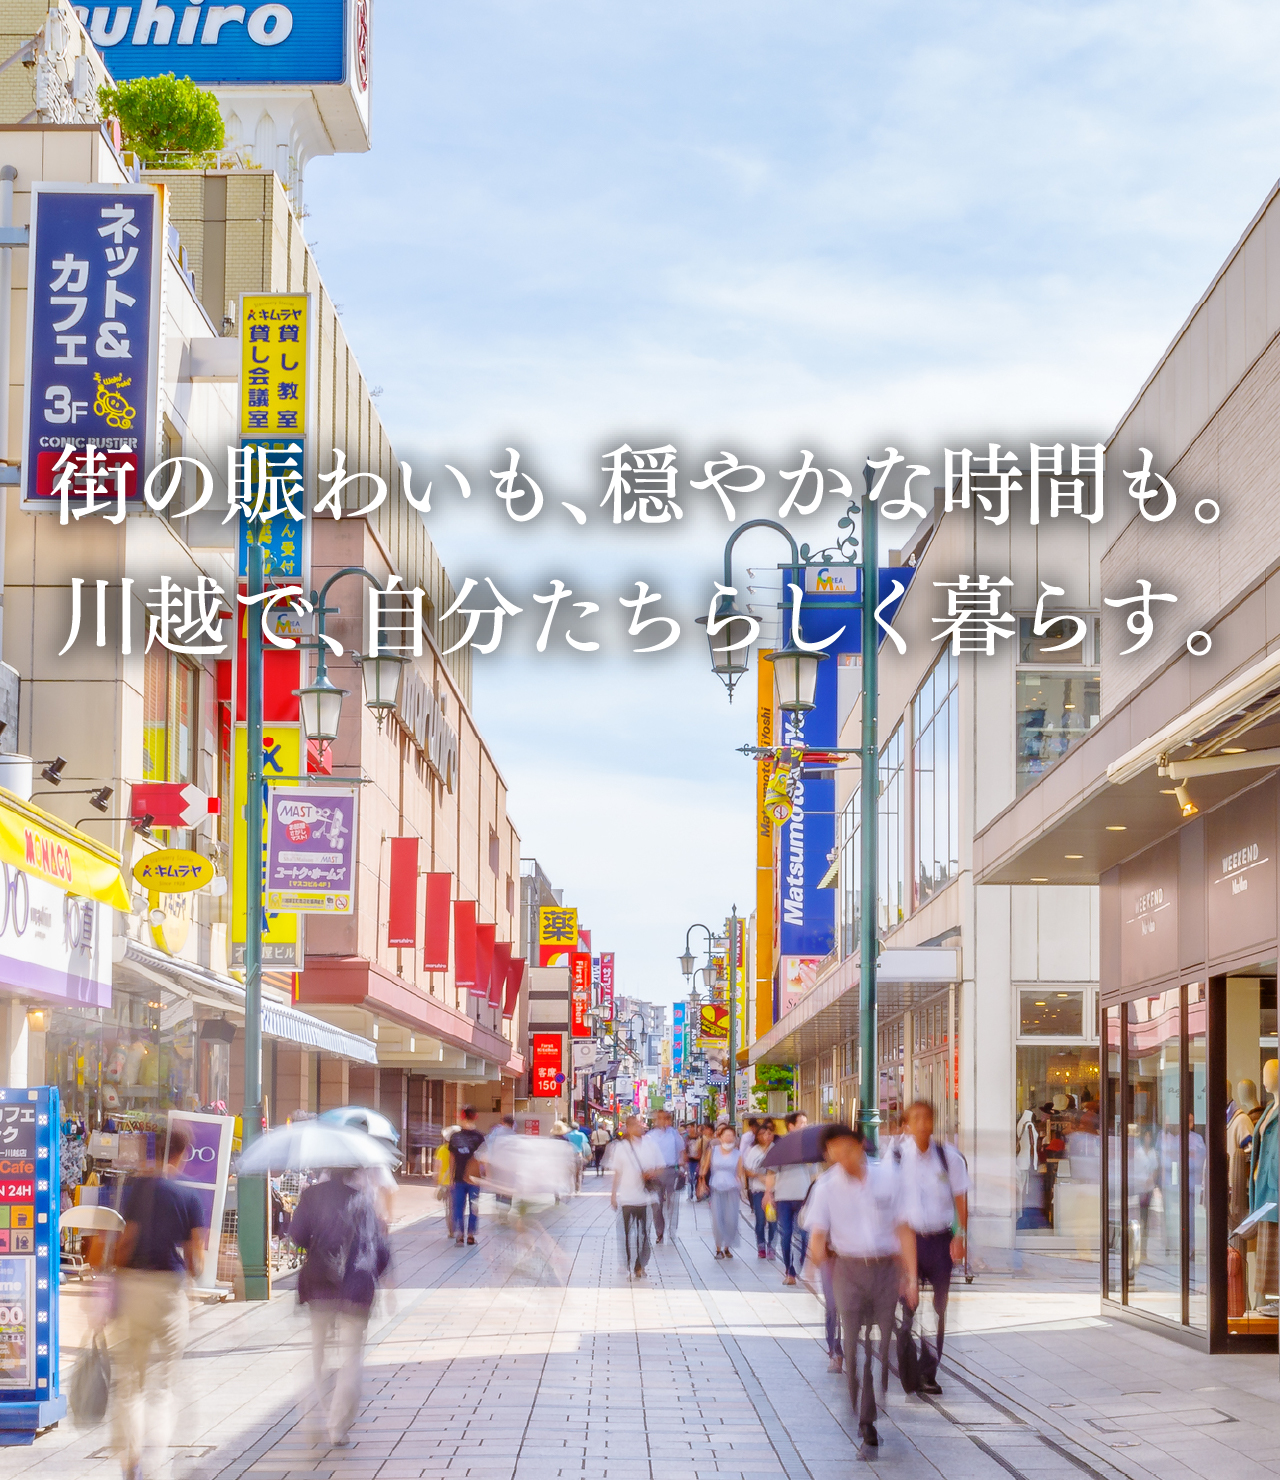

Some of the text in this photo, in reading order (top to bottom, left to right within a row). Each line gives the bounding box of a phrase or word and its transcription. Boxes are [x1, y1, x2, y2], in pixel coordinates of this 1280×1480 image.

[82, 0, 293, 46] uhiro
[49, 253, 89, 365] カフェ
[247, 324, 270, 428] 貸し会議室
[277, 324, 299, 428] 貸し教室
[44, 385, 88, 424] 3F
[280, 806, 312, 817] MAST
[24, 827, 72, 882] MONACO
[1222, 843, 1259, 874] WEEKEND
[155, 865, 202, 877] キムラヤ
[1135, 887, 1163, 913] WEEKEND
[543, 911, 574, 941] 薬
[235, 946, 295, 959] 木屋ビル
[538, 1081, 557, 1090] 150
[0, 1160, 34, 1173] Cafe
[8, 1185, 31, 1196] 24H
